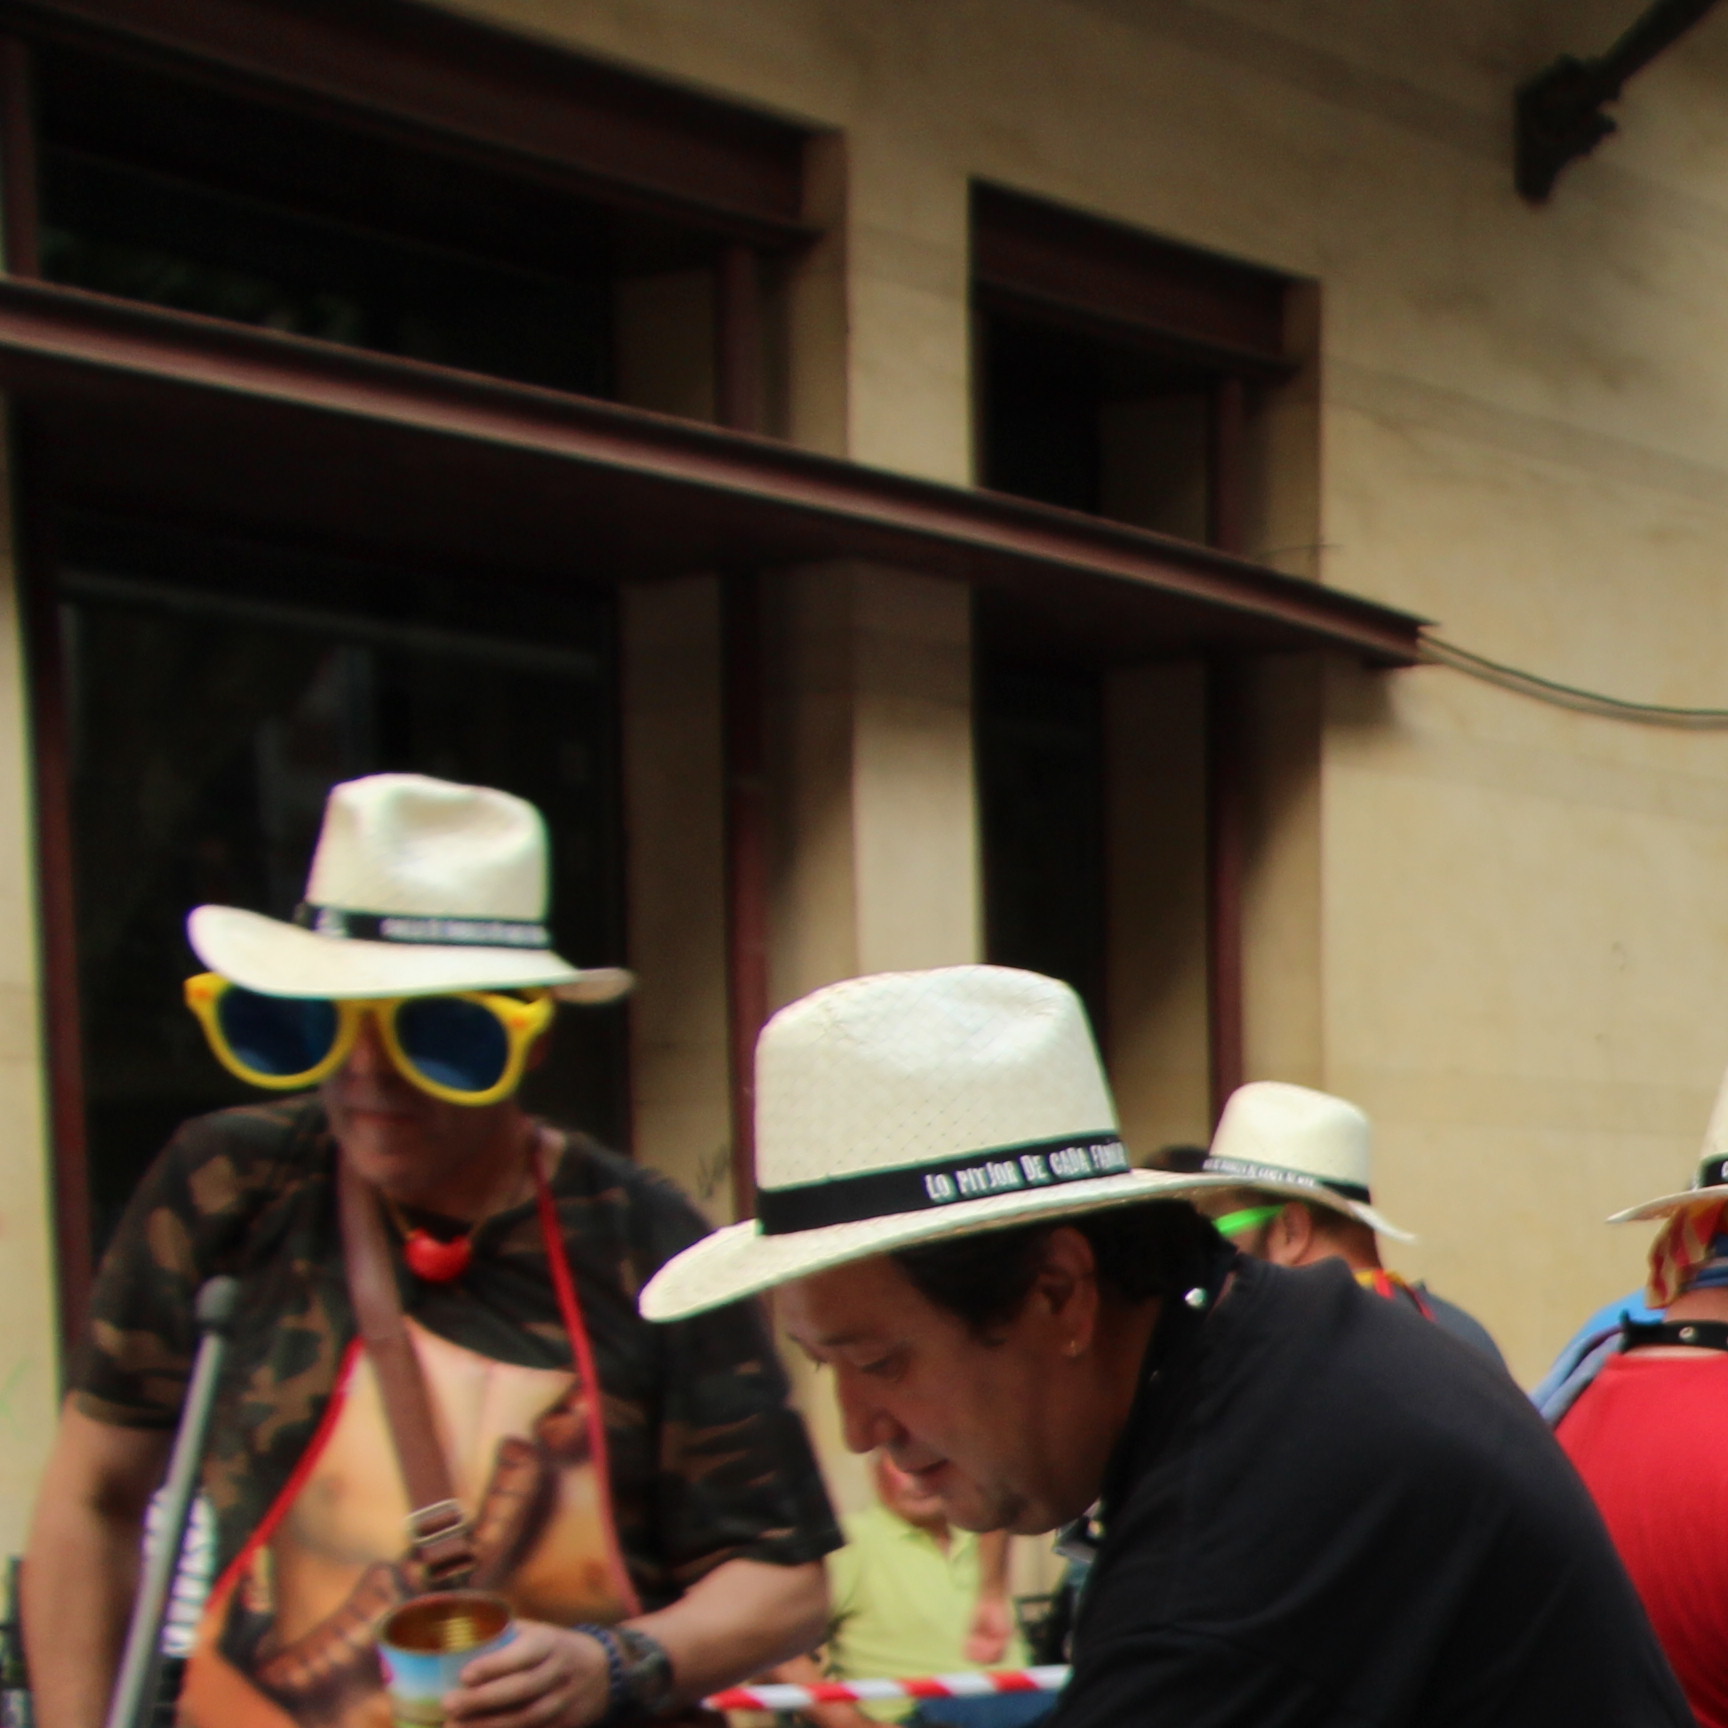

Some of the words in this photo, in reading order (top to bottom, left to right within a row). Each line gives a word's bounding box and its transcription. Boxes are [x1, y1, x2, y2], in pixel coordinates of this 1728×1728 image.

[956, 1160, 1019, 1194] PITJOR
[1020, 1154, 1048, 1182] DE
[1050, 1147, 1091, 1176] CADA
